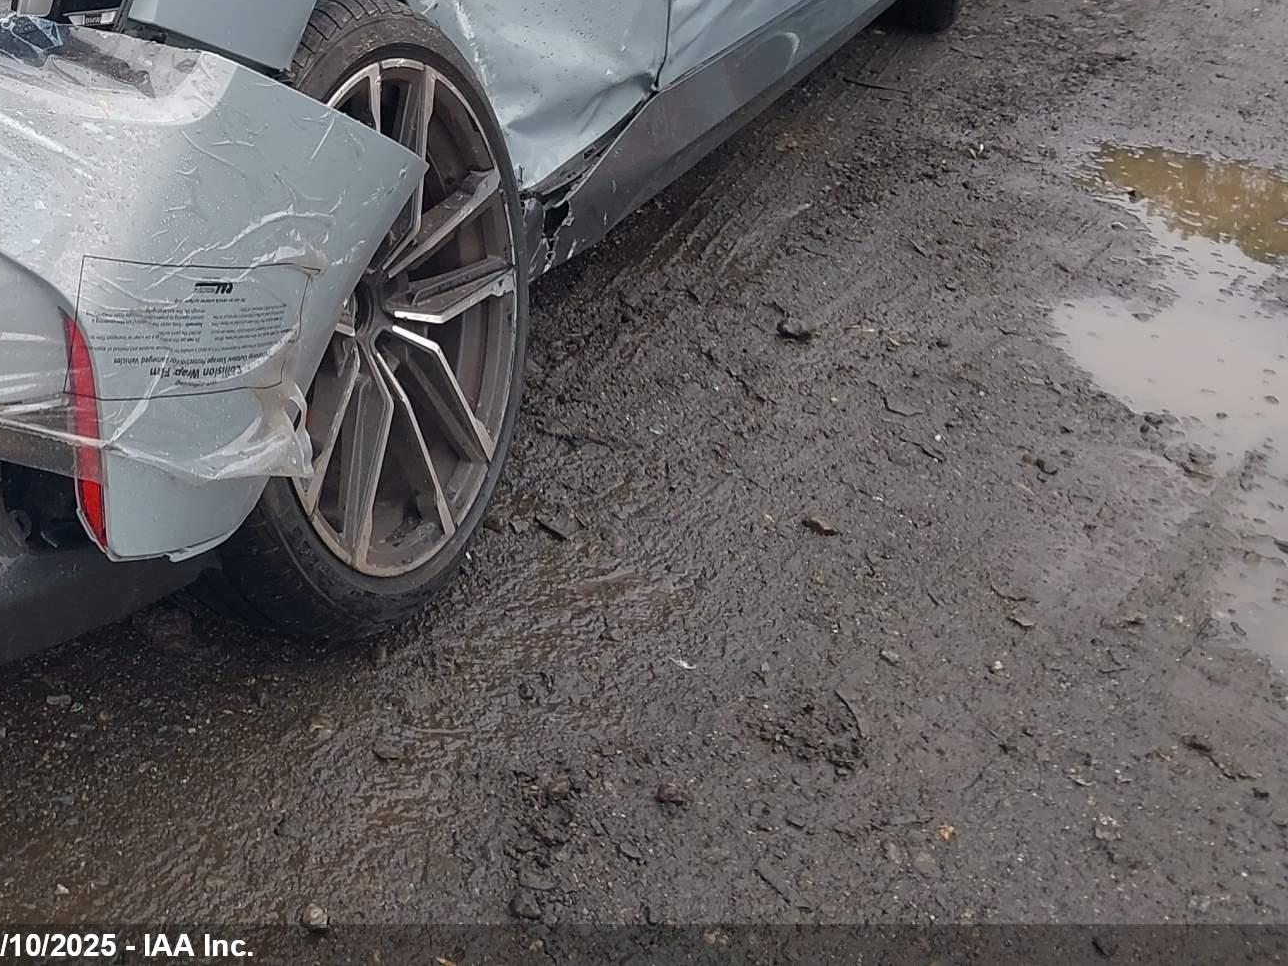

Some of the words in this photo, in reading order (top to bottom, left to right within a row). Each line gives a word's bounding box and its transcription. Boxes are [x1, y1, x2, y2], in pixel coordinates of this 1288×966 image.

[113, 357, 140, 366] Vehicles
[175, 366, 200, 379] Wrap
[203, 364, 242, 379] Collision
